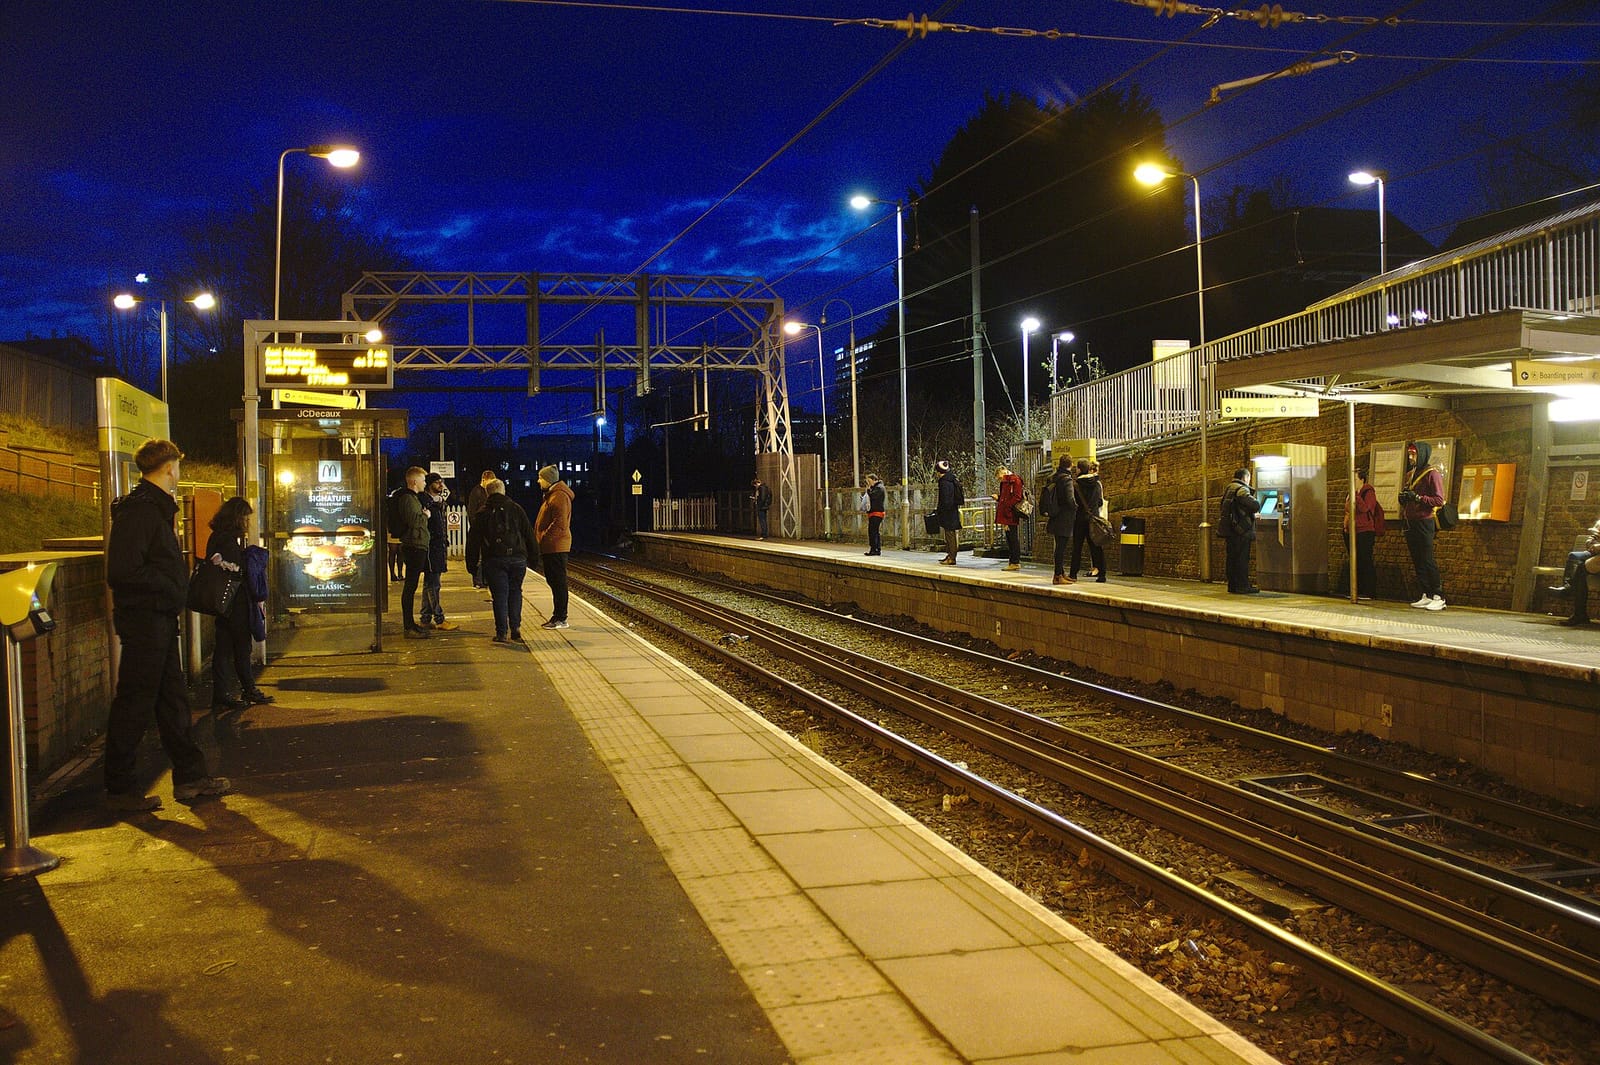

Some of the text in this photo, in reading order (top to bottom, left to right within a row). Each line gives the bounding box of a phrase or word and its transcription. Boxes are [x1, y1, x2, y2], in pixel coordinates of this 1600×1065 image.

[1540, 371, 1584, 381] Boarding point
[297, 409, 341, 418] JCDecaux
